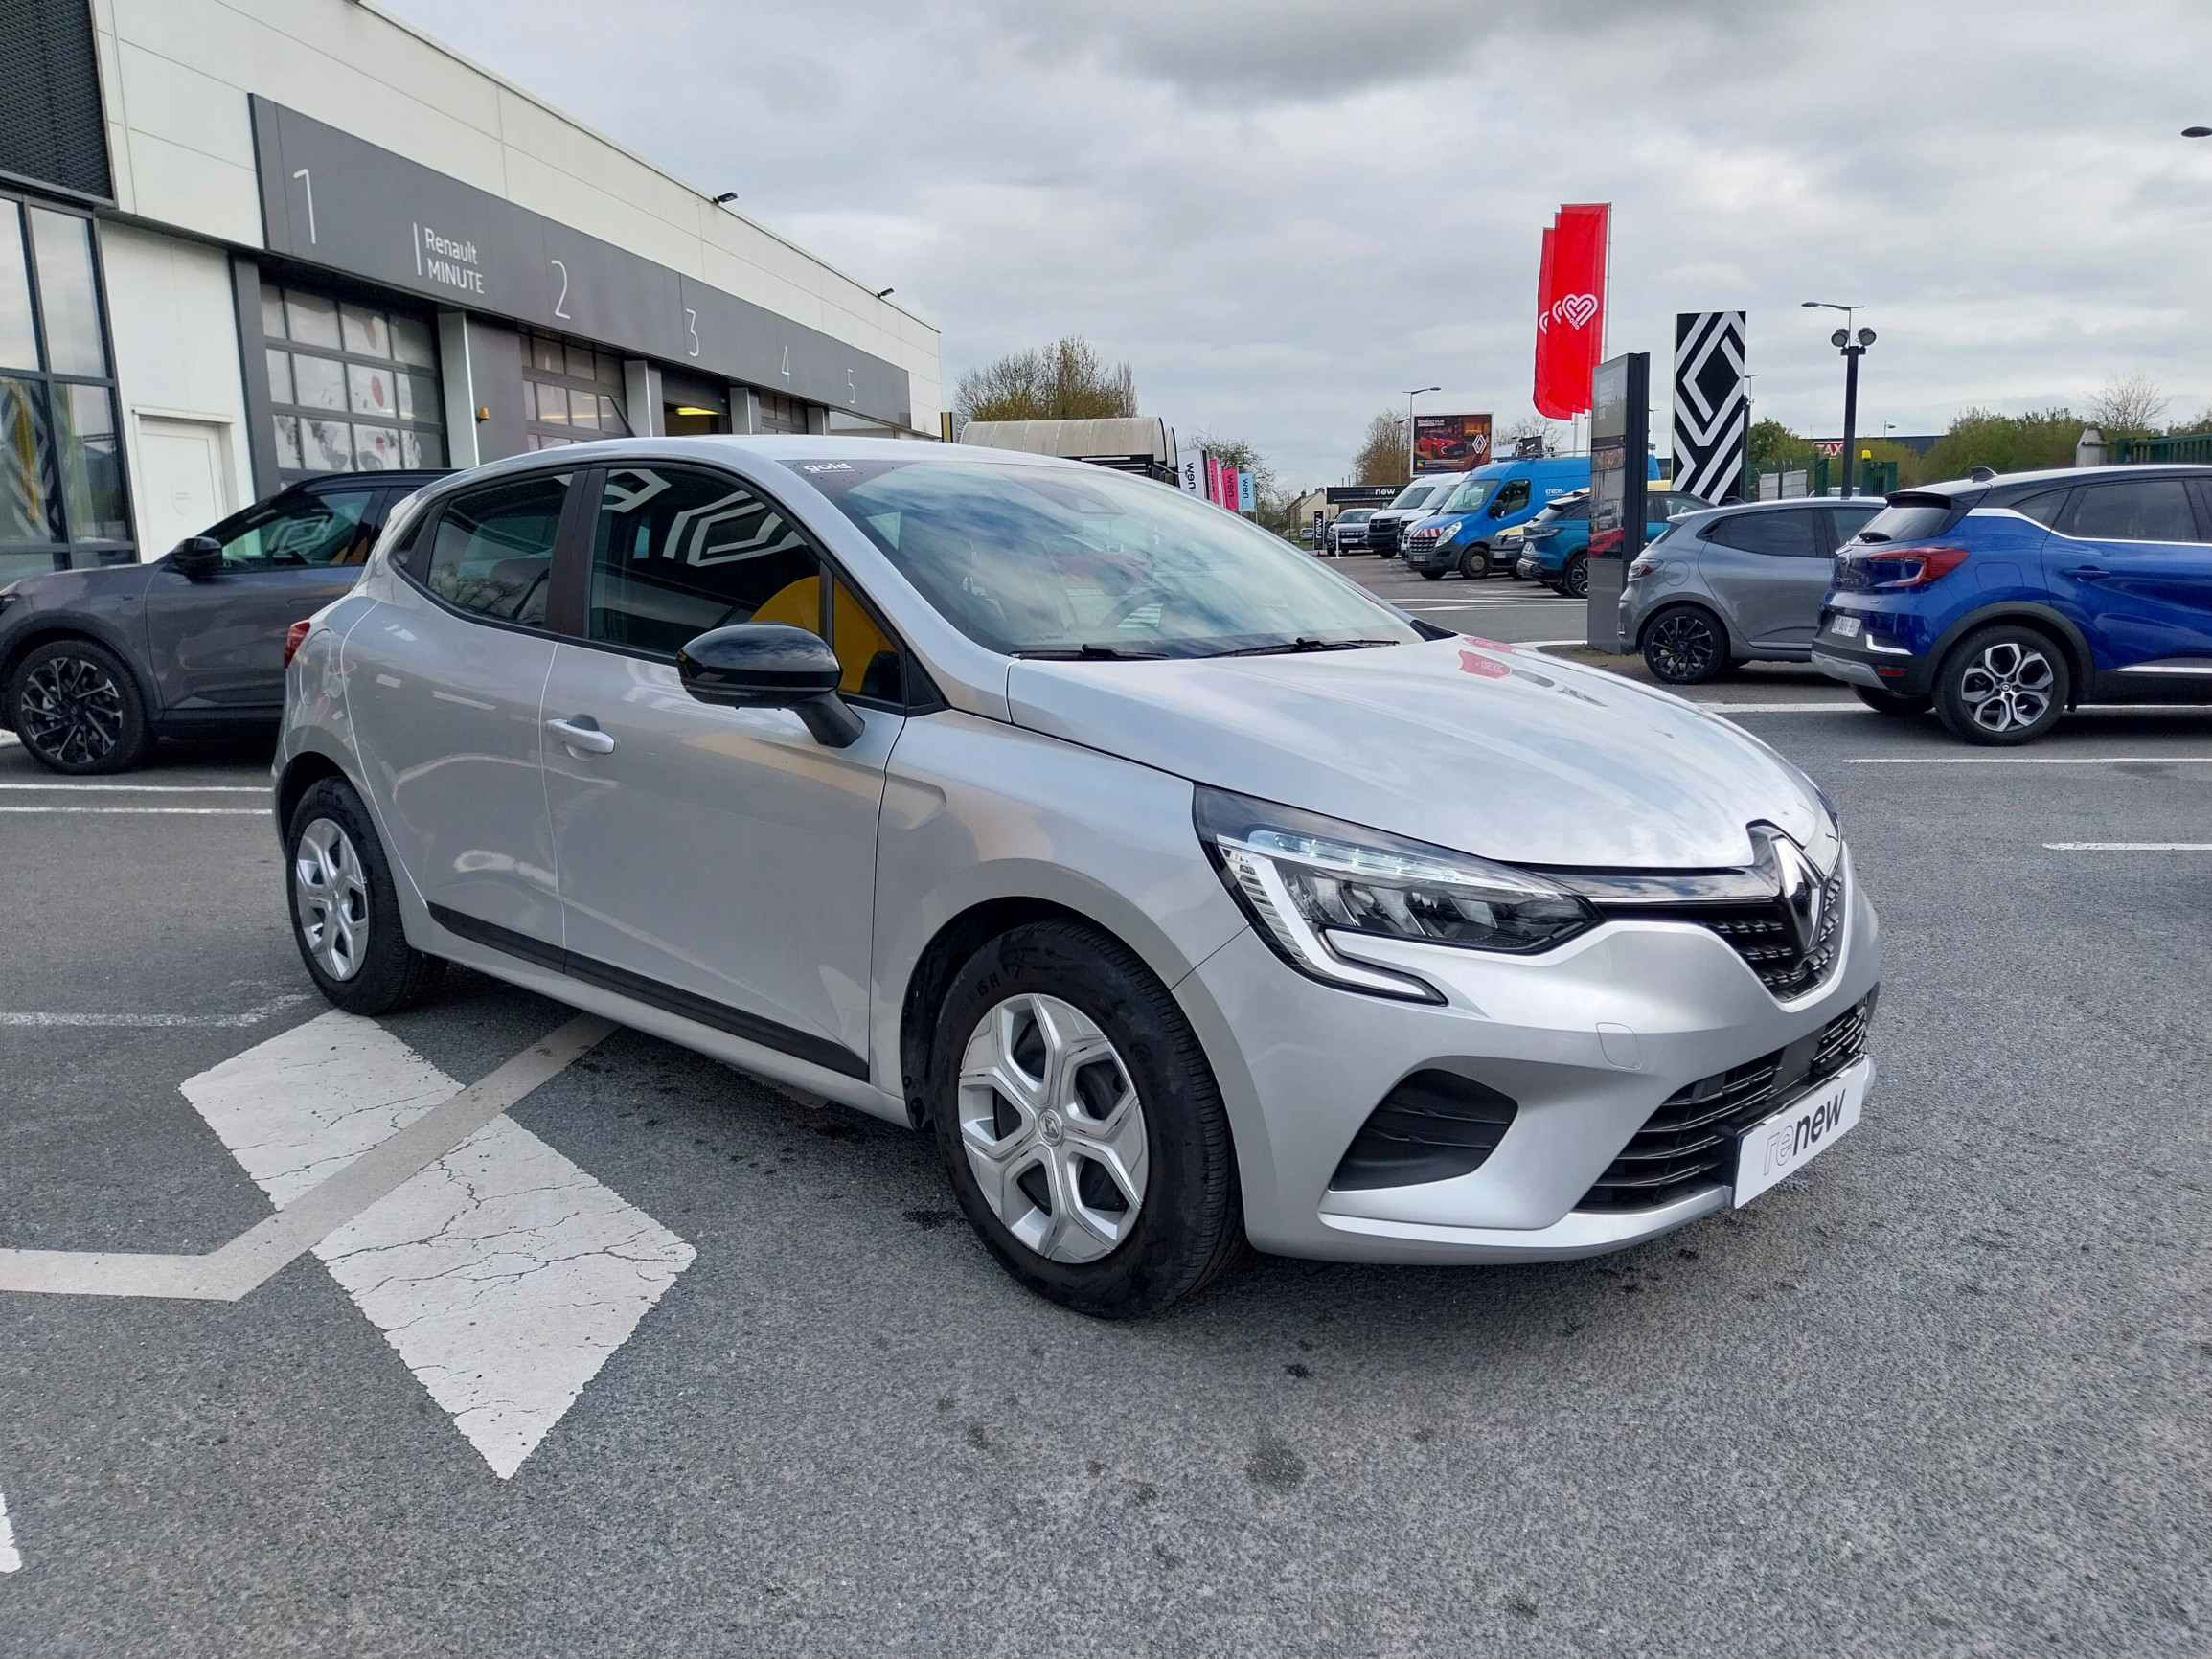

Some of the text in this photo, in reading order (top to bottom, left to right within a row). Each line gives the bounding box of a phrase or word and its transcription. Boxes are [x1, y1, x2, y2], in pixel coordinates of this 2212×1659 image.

[293, 168, 317, 245] 1
[423, 226, 479, 265] Renault
[426, 258, 485, 295] MINUTE
[551, 260, 571, 320] 2
[685, 307, 700, 357] 3
[781, 345, 792, 384] 4
[846, 368, 856, 404] 5
[803, 463, 853, 472] gold
[1763, 1088, 1847, 1177] renew
